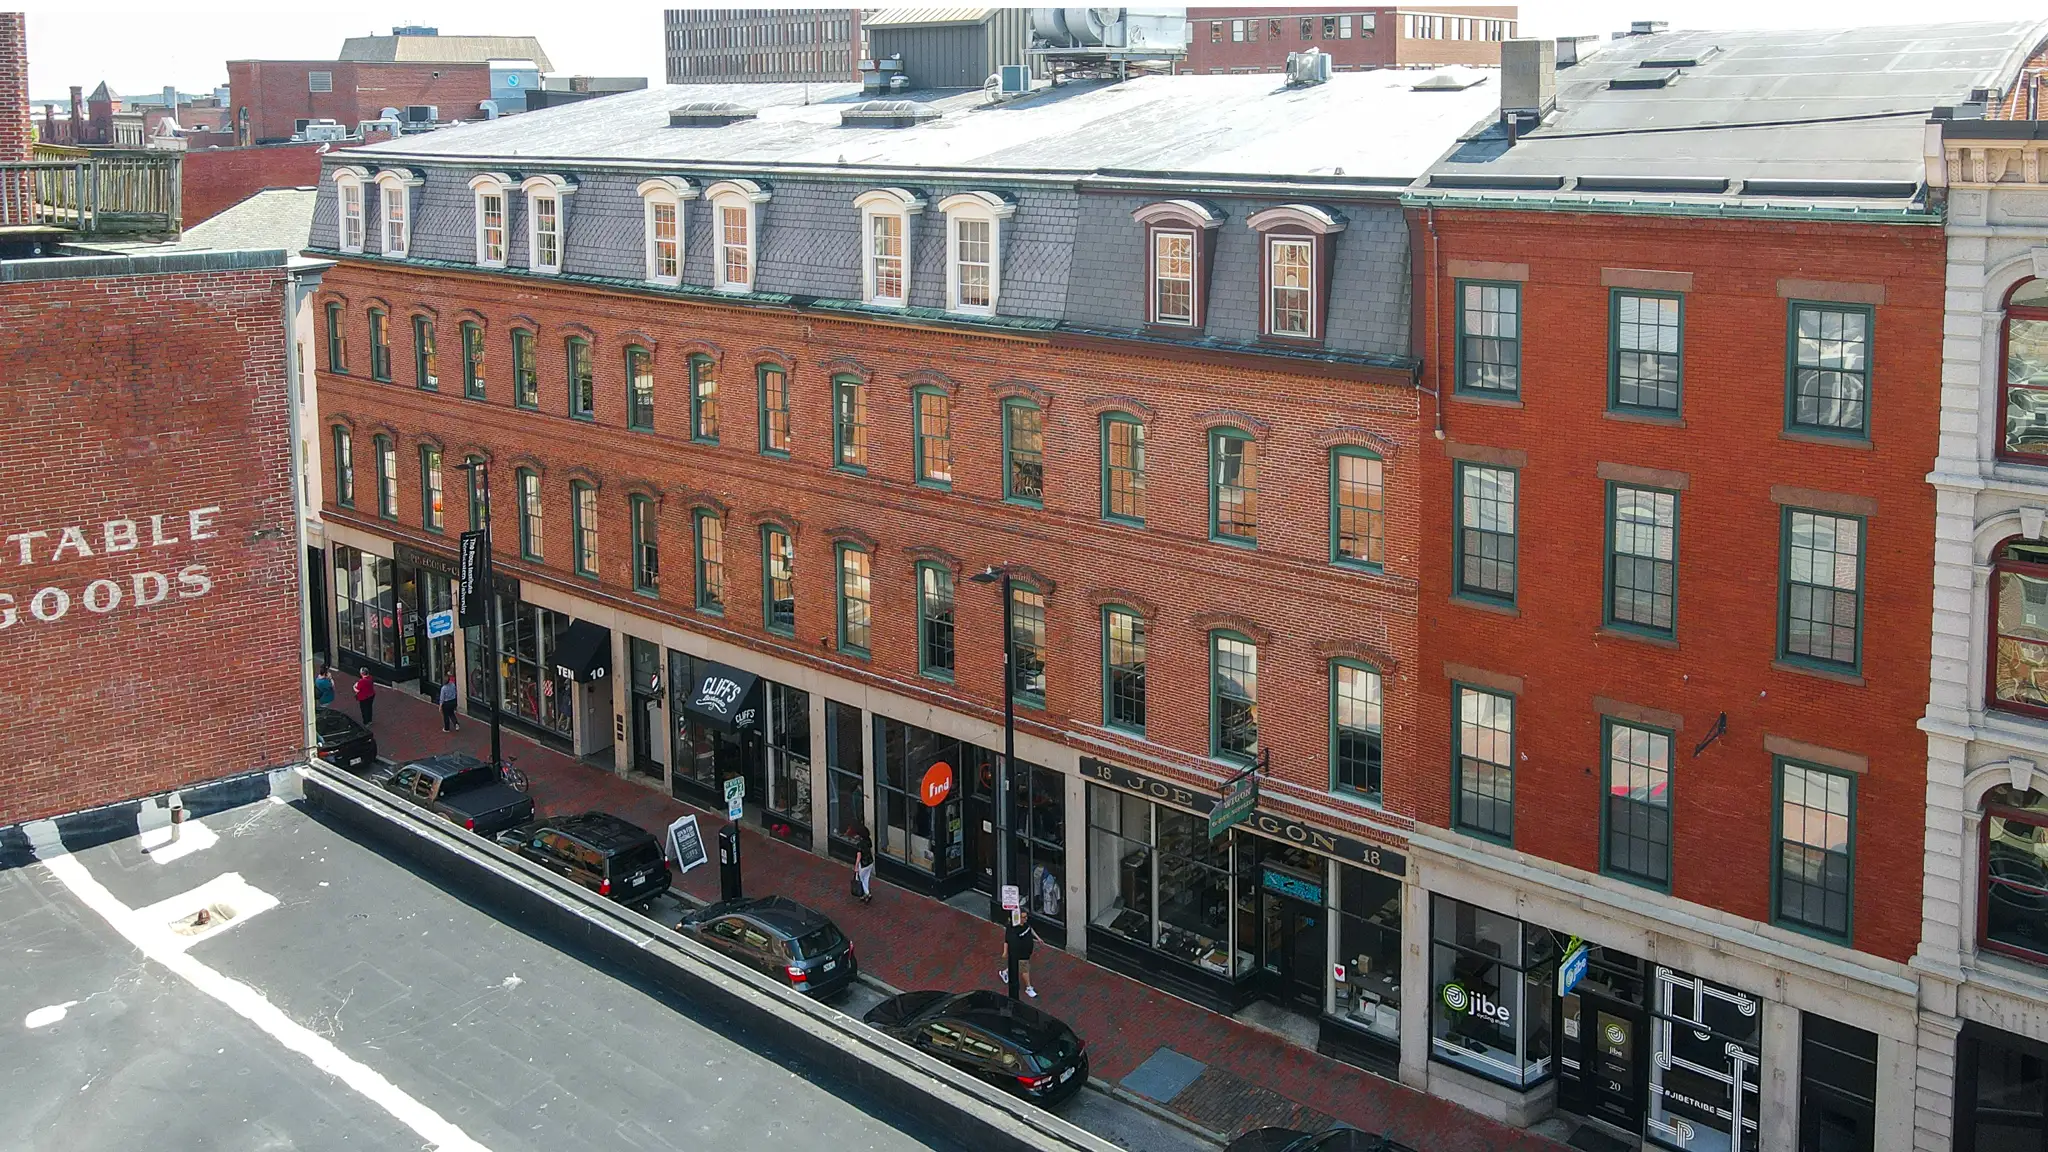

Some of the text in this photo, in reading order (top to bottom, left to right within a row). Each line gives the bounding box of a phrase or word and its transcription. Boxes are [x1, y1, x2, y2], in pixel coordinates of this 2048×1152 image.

[0, 506, 220, 565] TABLE
[459, 581, 468, 615] University
[556, 664, 605, 680] TEN 10
[702, 676, 742, 703] CLIFF'S
[735, 708, 756, 724] CLIFF'S
[929, 776, 950, 798] find
[1223, 787, 1252, 809] WIGON
[1096, 765, 1381, 866] 18 JOE IGON 18
[1573, 957, 1587, 982] jibe
[1468, 990, 1510, 1021] jibe
[1608, 1046, 1623, 1057] jibe
[1609, 1080, 1622, 1092] 20
[1664, 1089, 1716, 1114] #JIBETRIBE
